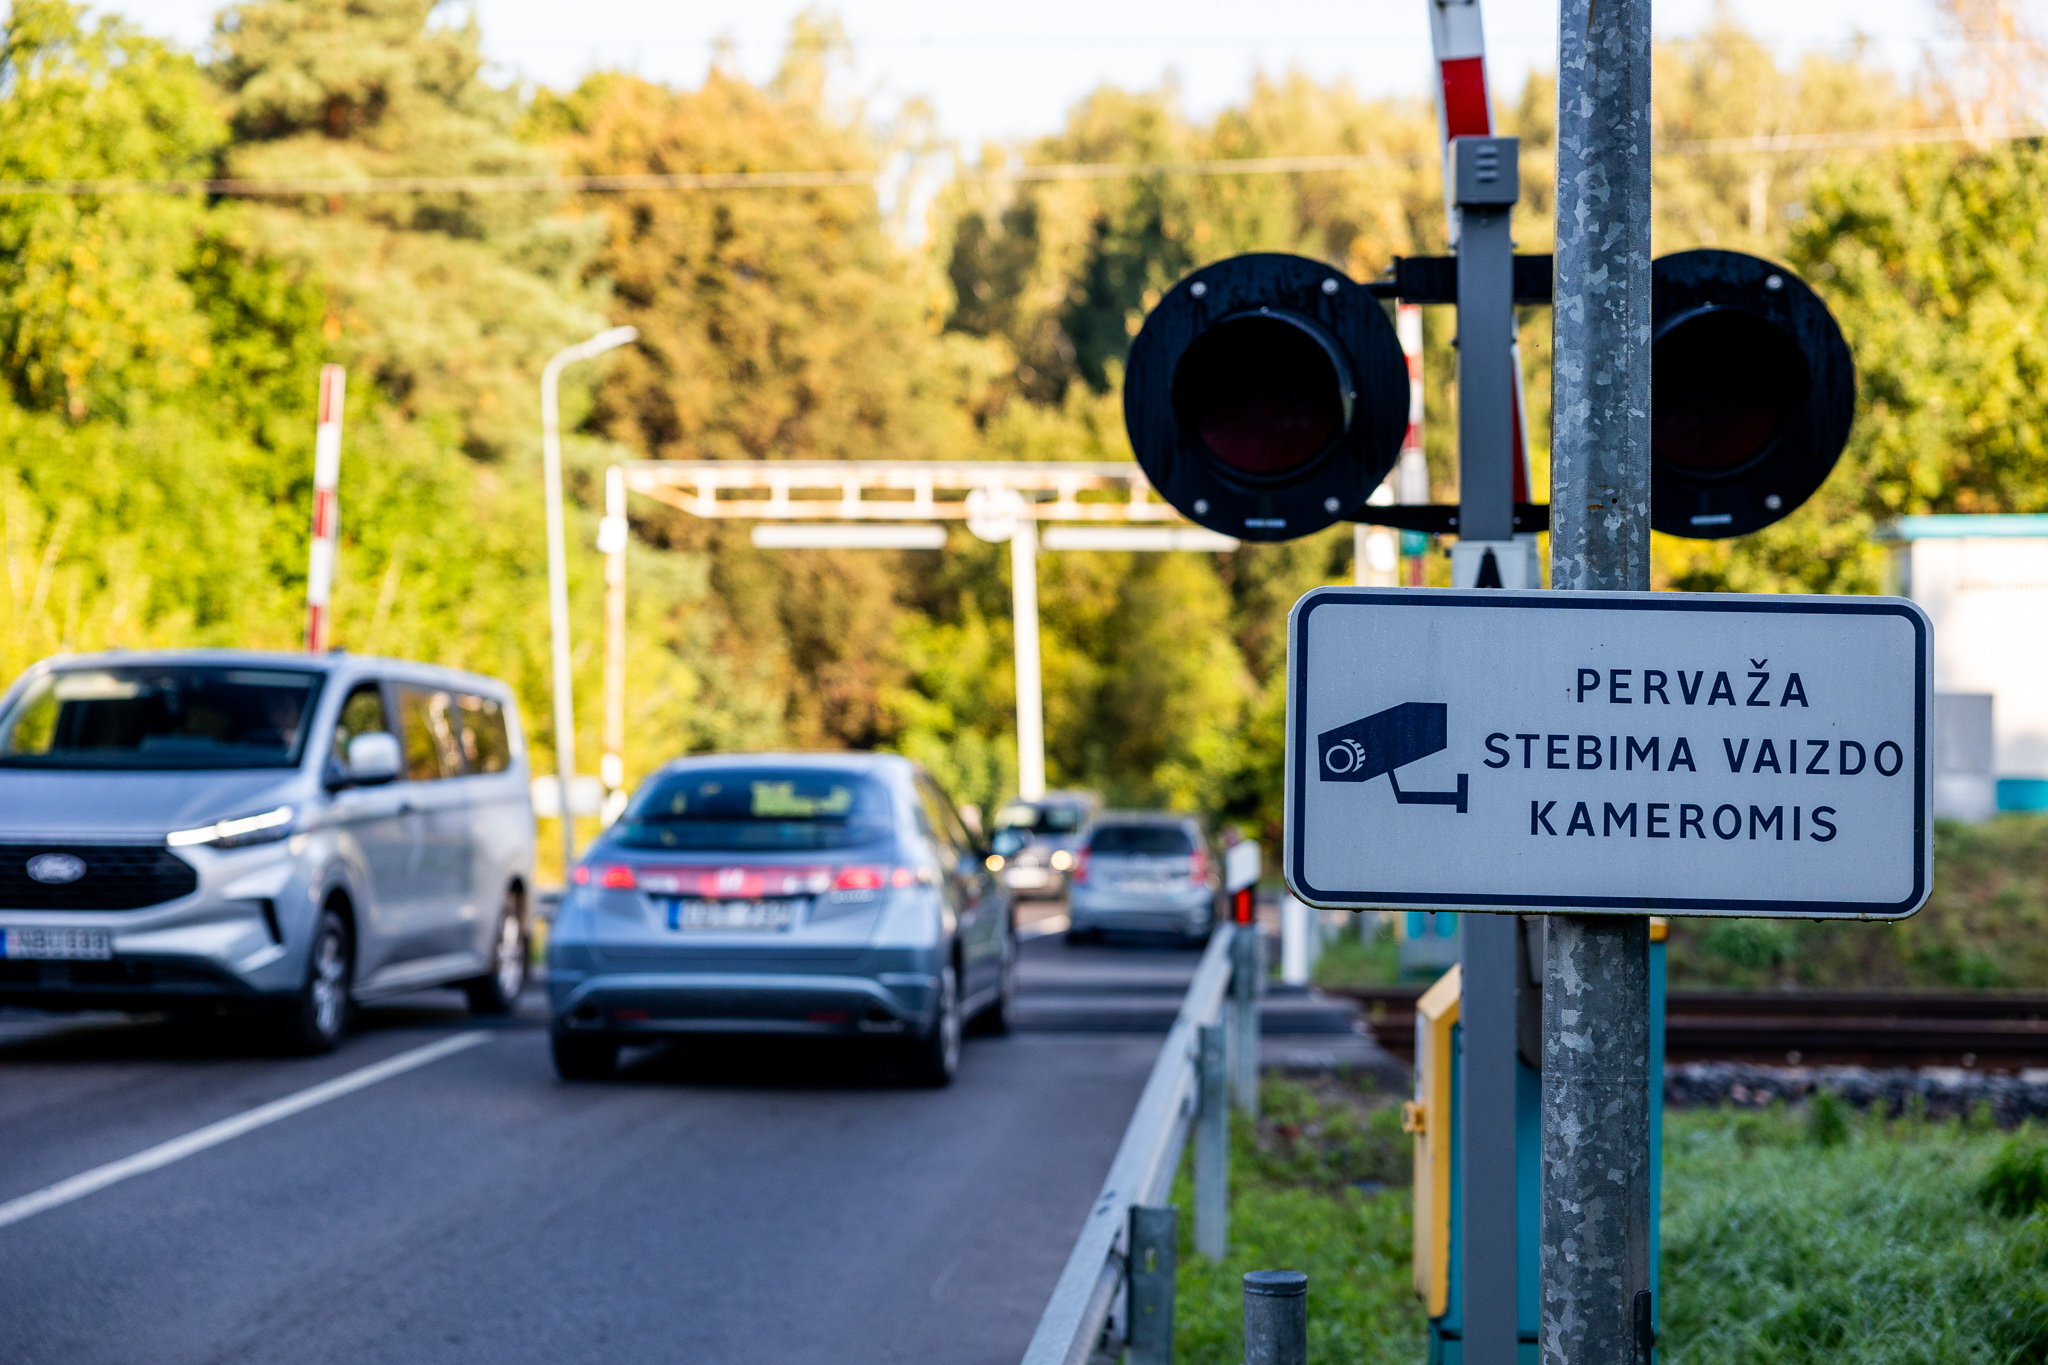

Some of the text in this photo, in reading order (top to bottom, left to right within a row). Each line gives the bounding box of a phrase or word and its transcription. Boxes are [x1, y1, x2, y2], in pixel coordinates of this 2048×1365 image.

[1577, 659, 1810, 708] PERVAŽA
[1483, 733, 1904, 777] STEBIMA VAIZDO
[1531, 801, 1838, 843] KAMEROMIS
